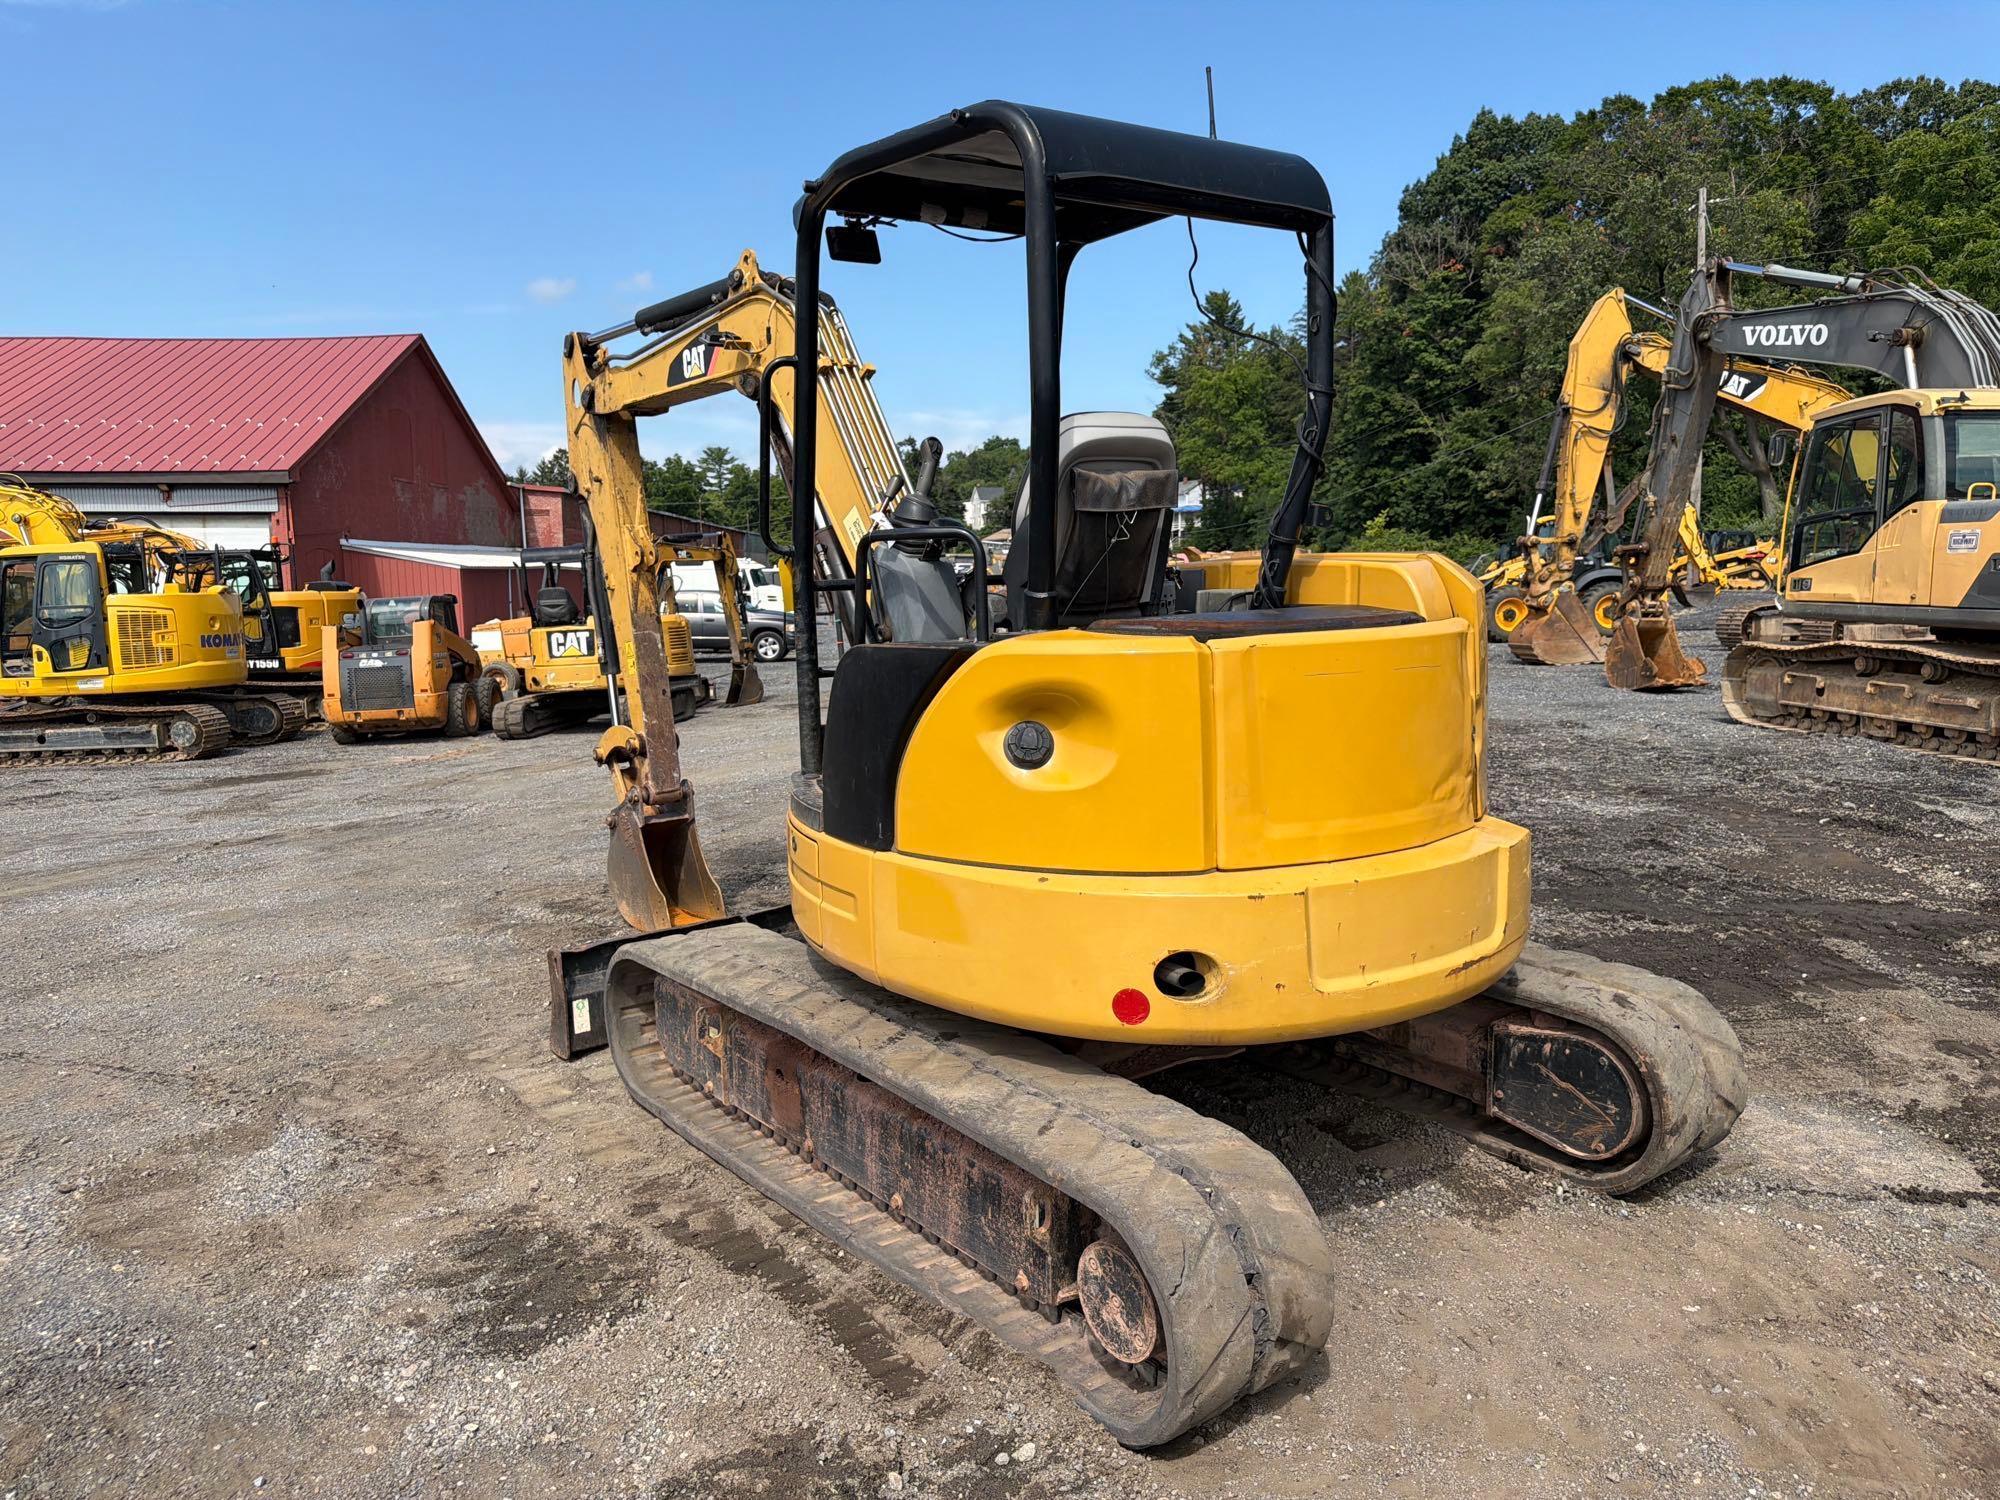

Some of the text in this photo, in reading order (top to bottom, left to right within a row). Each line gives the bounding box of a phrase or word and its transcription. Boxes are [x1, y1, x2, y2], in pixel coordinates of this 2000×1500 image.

[1742, 323, 1829, 346] VOLVO
[682, 343, 706, 379] CAT
[550, 631, 590, 657] CAT
